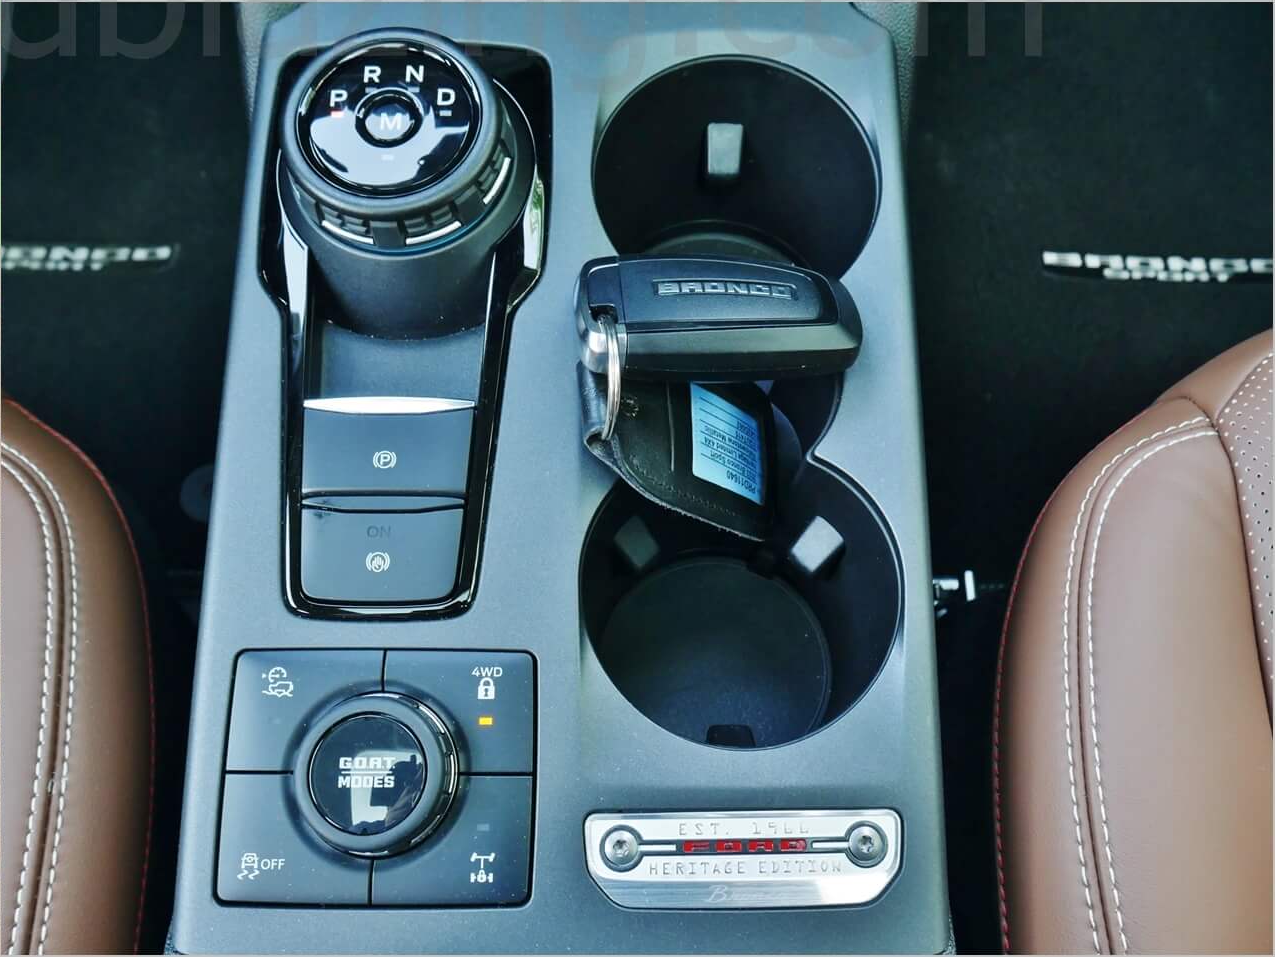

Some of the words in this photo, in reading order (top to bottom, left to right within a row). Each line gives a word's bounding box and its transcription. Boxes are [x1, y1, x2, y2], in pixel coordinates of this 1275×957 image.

[363, 65, 381, 83] R
[405, 65, 424, 83] N
[329, 89, 348, 107] P
[436, 88, 456, 106] D
[380, 113, 401, 130] M
[657, 281, 792, 299] BRONCO
[366, 525, 391, 538] ON
[471, 667, 503, 677] 4WD
[338, 757, 396, 770] G.O.A.T.
[337, 775, 395, 789] MODES
[678, 822, 729, 836] EST.
[682, 839, 806, 853] FORD
[260, 859, 285, 870] OFF
[649, 862, 745, 876] HERITAGE
[758, 860, 842, 875] EDITION
